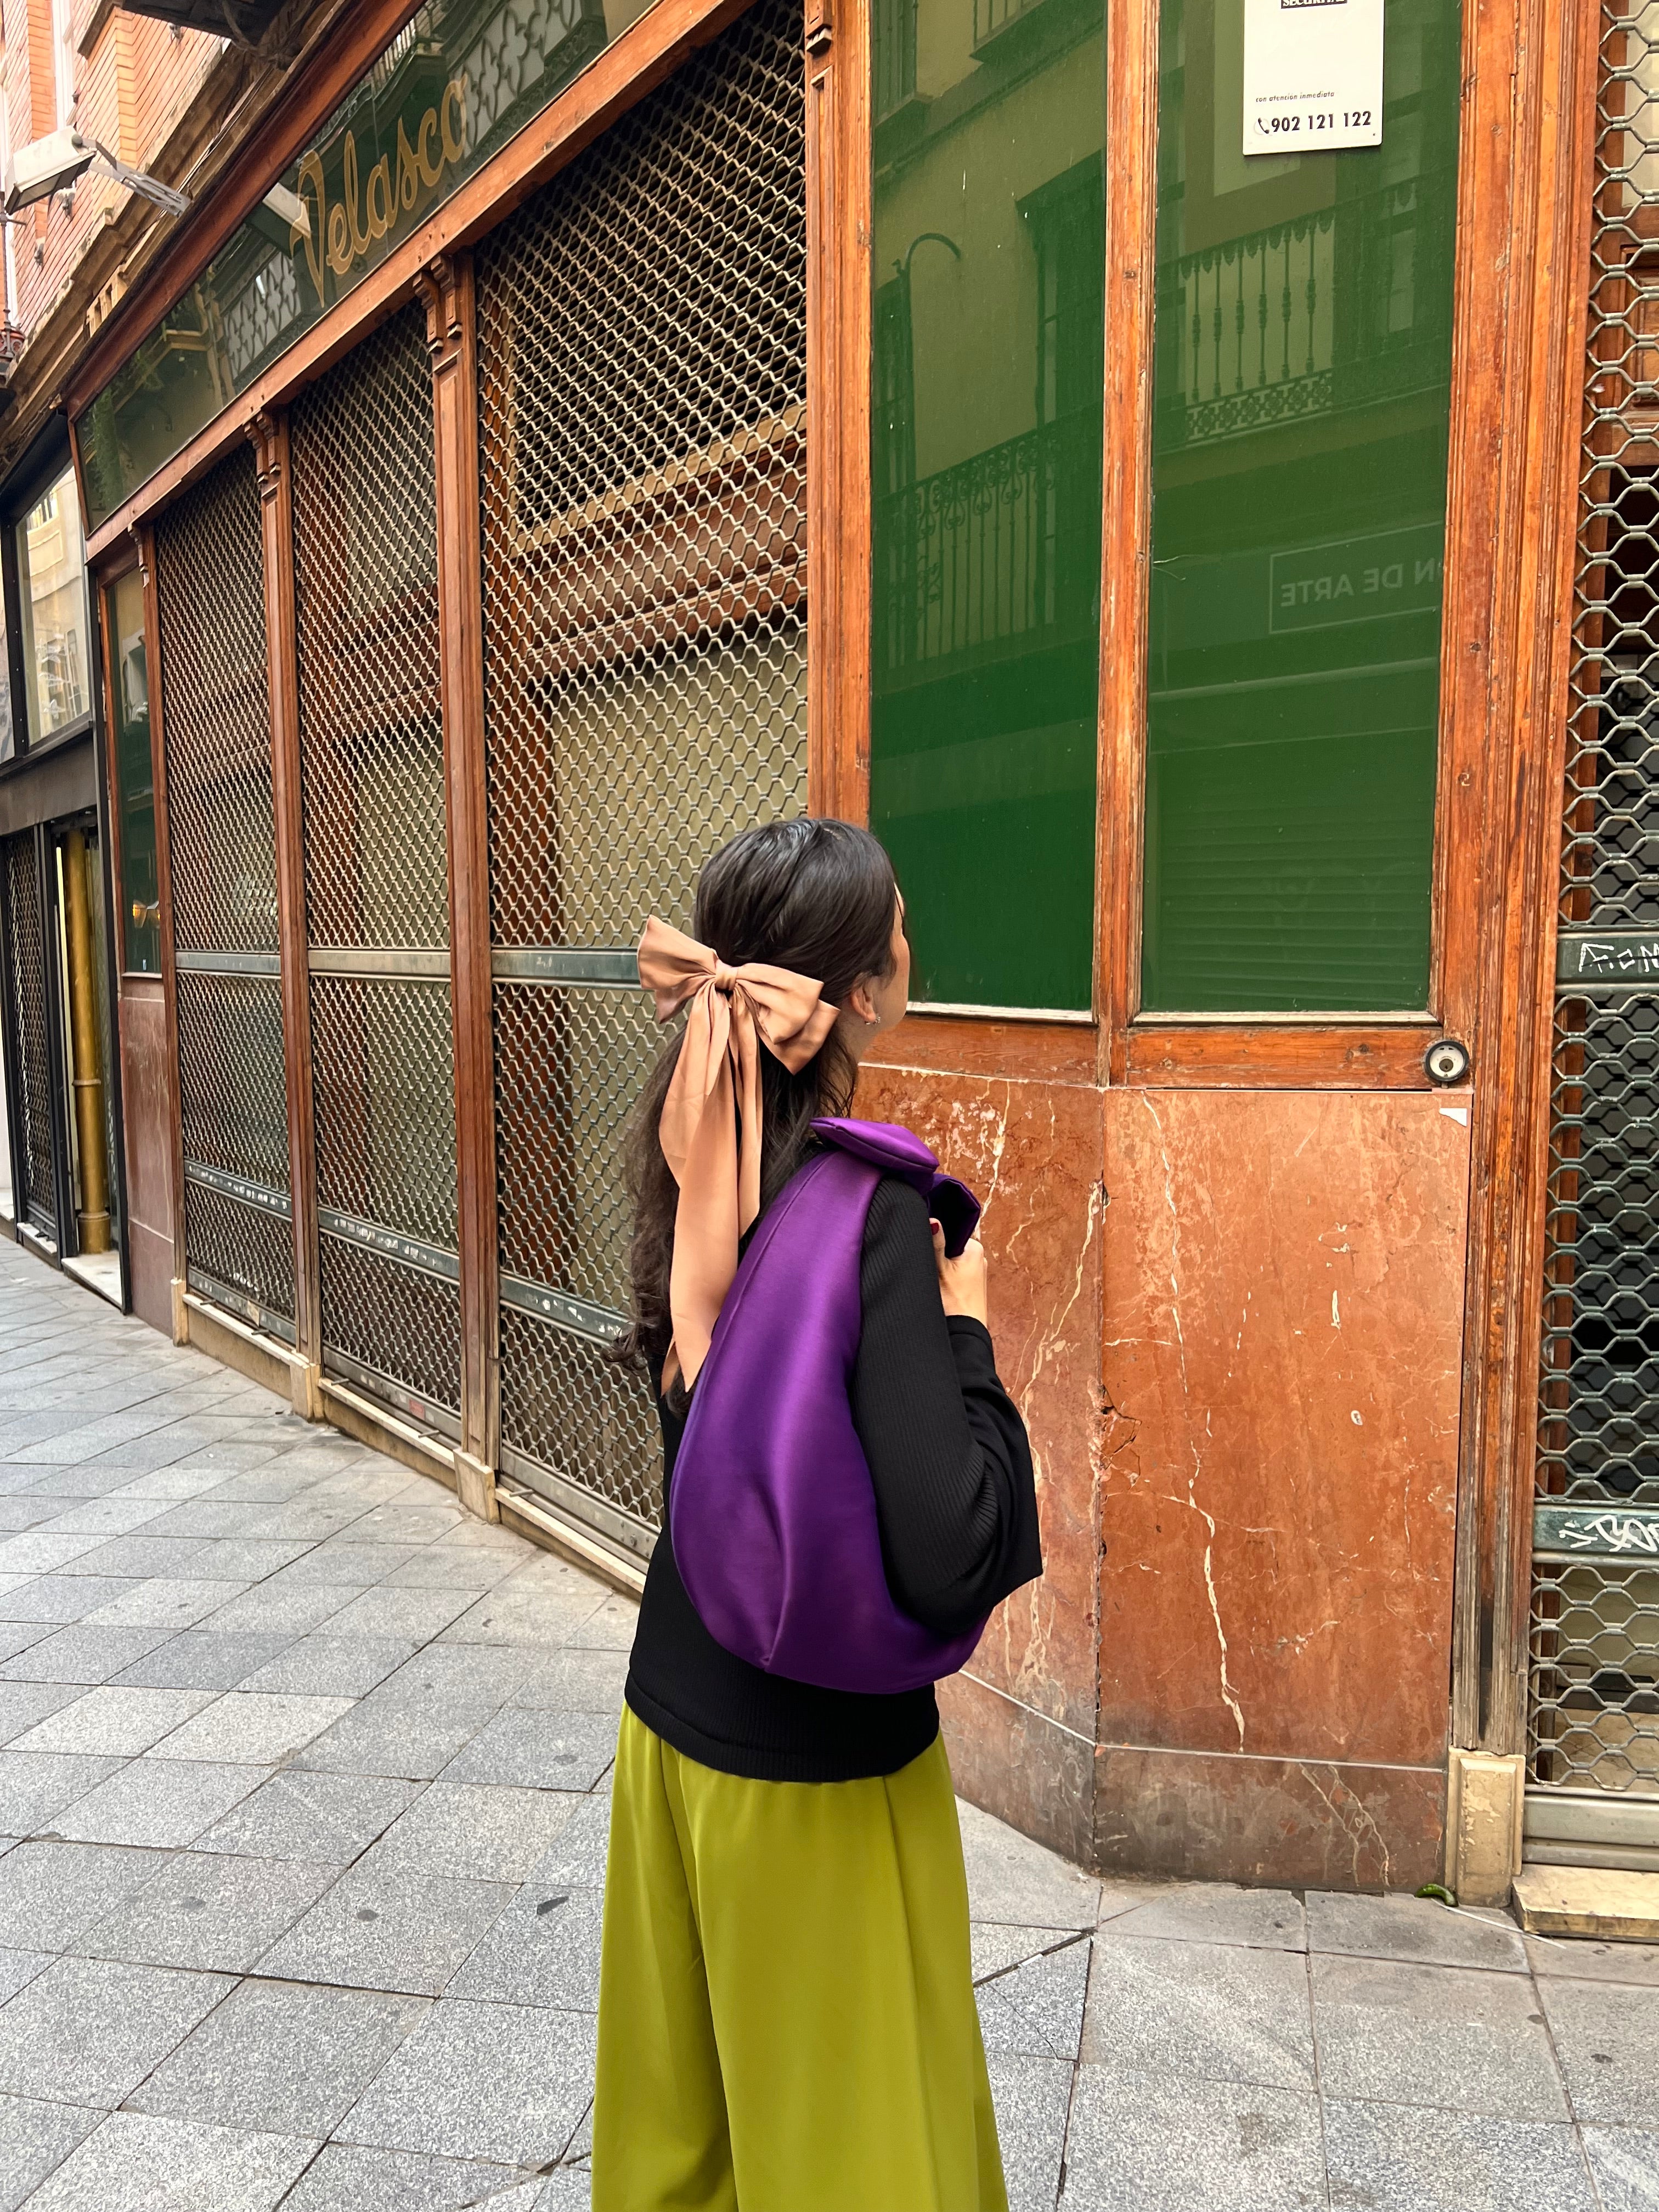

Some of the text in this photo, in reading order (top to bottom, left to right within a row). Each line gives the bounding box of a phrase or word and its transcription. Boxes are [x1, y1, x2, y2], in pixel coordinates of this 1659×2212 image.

[1269, 92, 1298, 102] atención
[1300, 91, 1335, 99] inmediata
[1271, 111, 1371, 132] 902 121 122
[290, 74, 469, 308] Velasco
